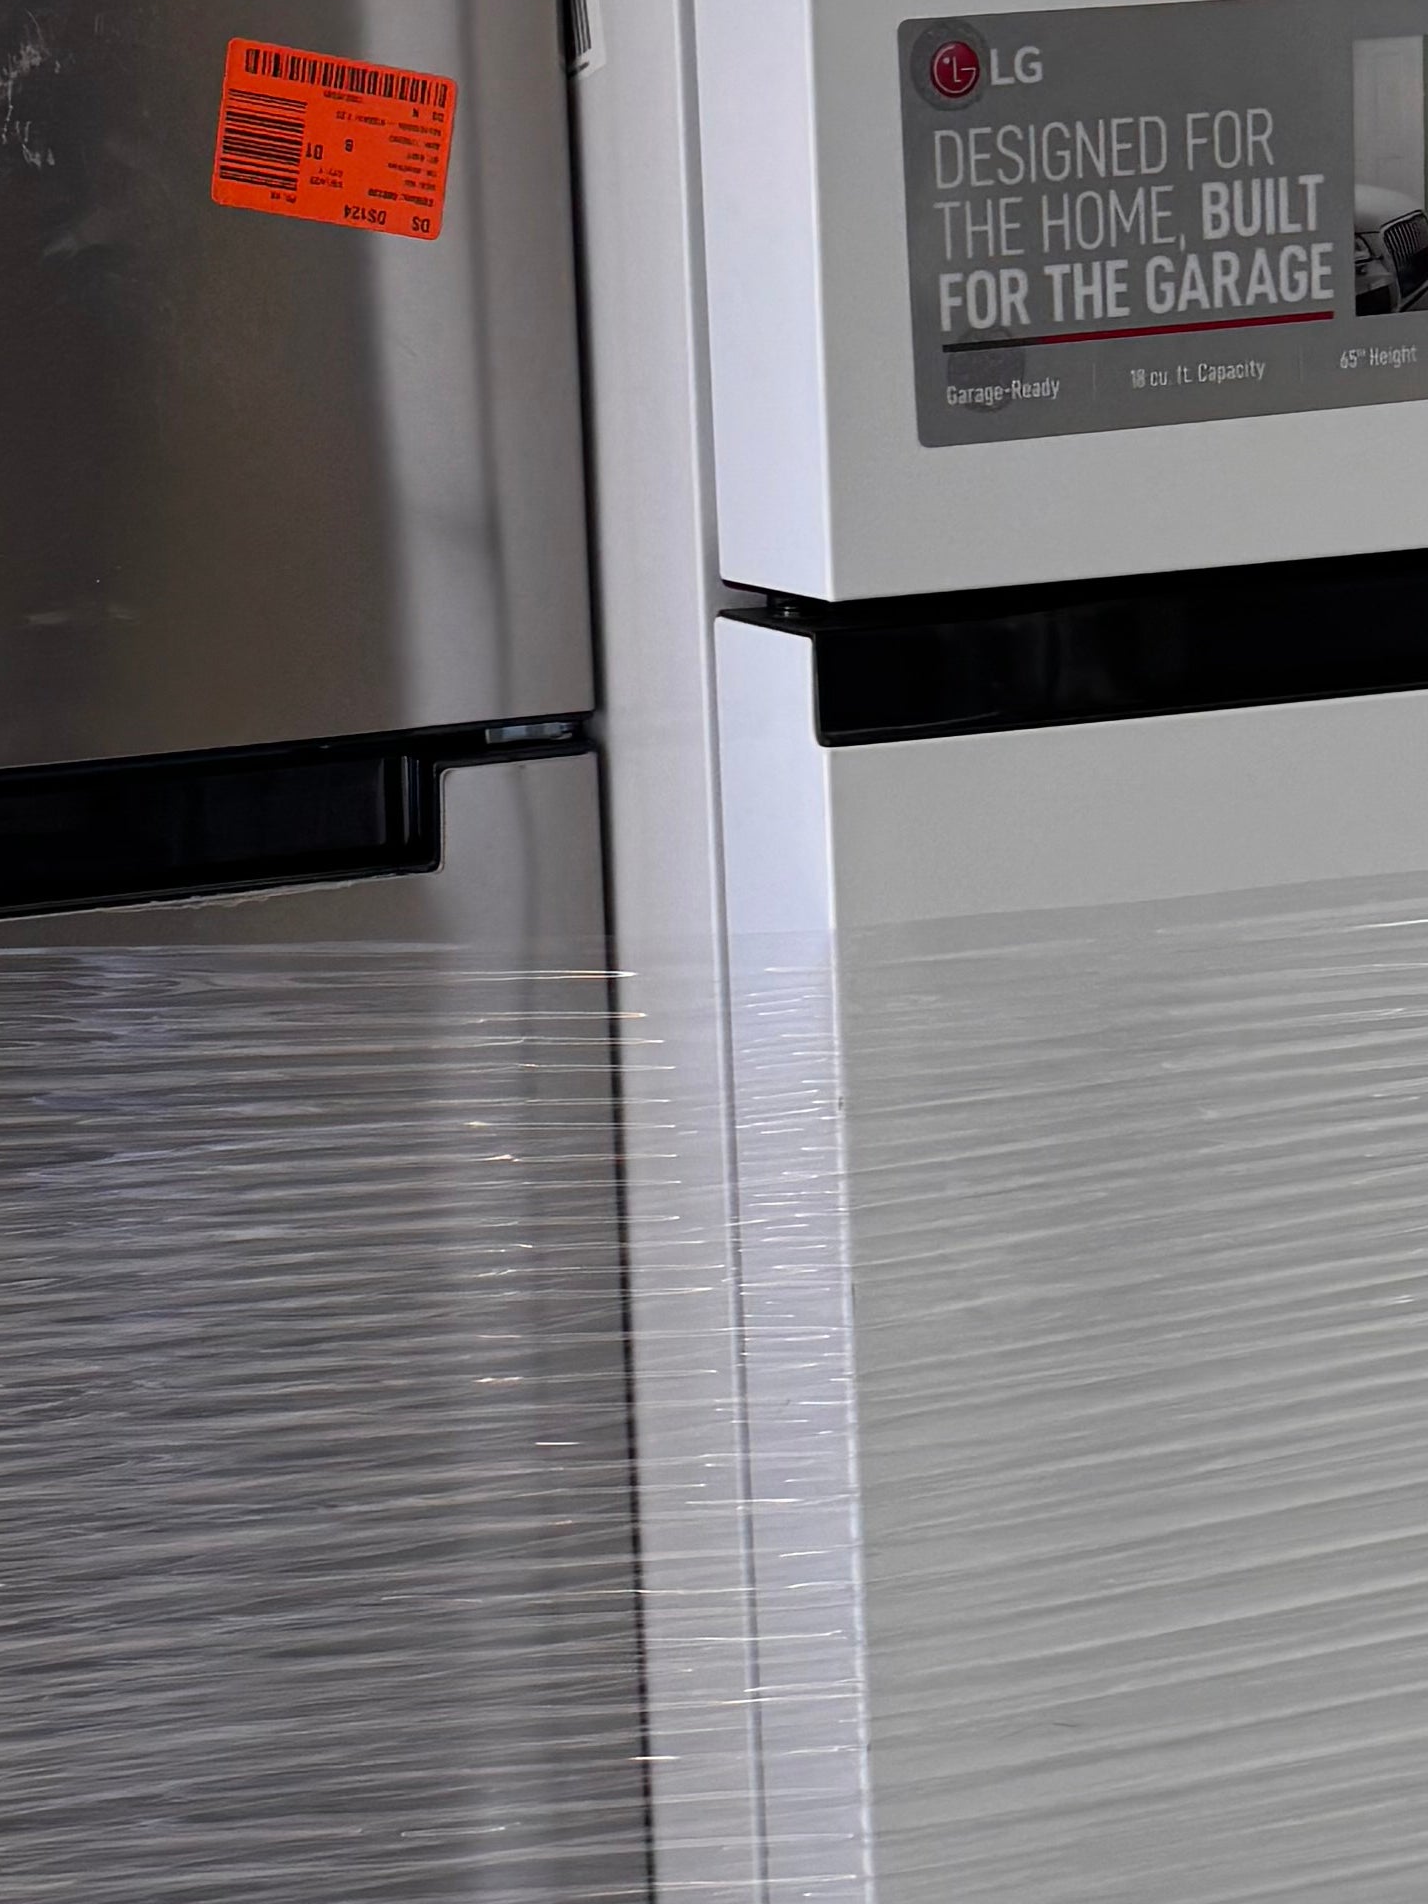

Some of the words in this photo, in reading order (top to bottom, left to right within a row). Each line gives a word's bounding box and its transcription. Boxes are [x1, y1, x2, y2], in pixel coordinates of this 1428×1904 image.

[990, 46, 1043, 86] LG
[934, 115, 1169, 189] DESIGNED
[1186, 108, 1275, 172] FOR
[344, 204, 387, 225] DS124
[412, 216, 431, 233] DS
[933, 196, 1026, 261] THE
[1042, 184, 1187, 253] HOME,
[1201, 174, 1325, 241] BUILT
[938, 267, 1032, 332] FOR
[1044, 259, 1132, 323] THE
[1145, 242, 1335, 315] GARAGE
[1369, 344, 1418, 369] Height
[1198, 359, 1266, 384] Capacity
[946, 377, 1061, 406] Garage-Ready
